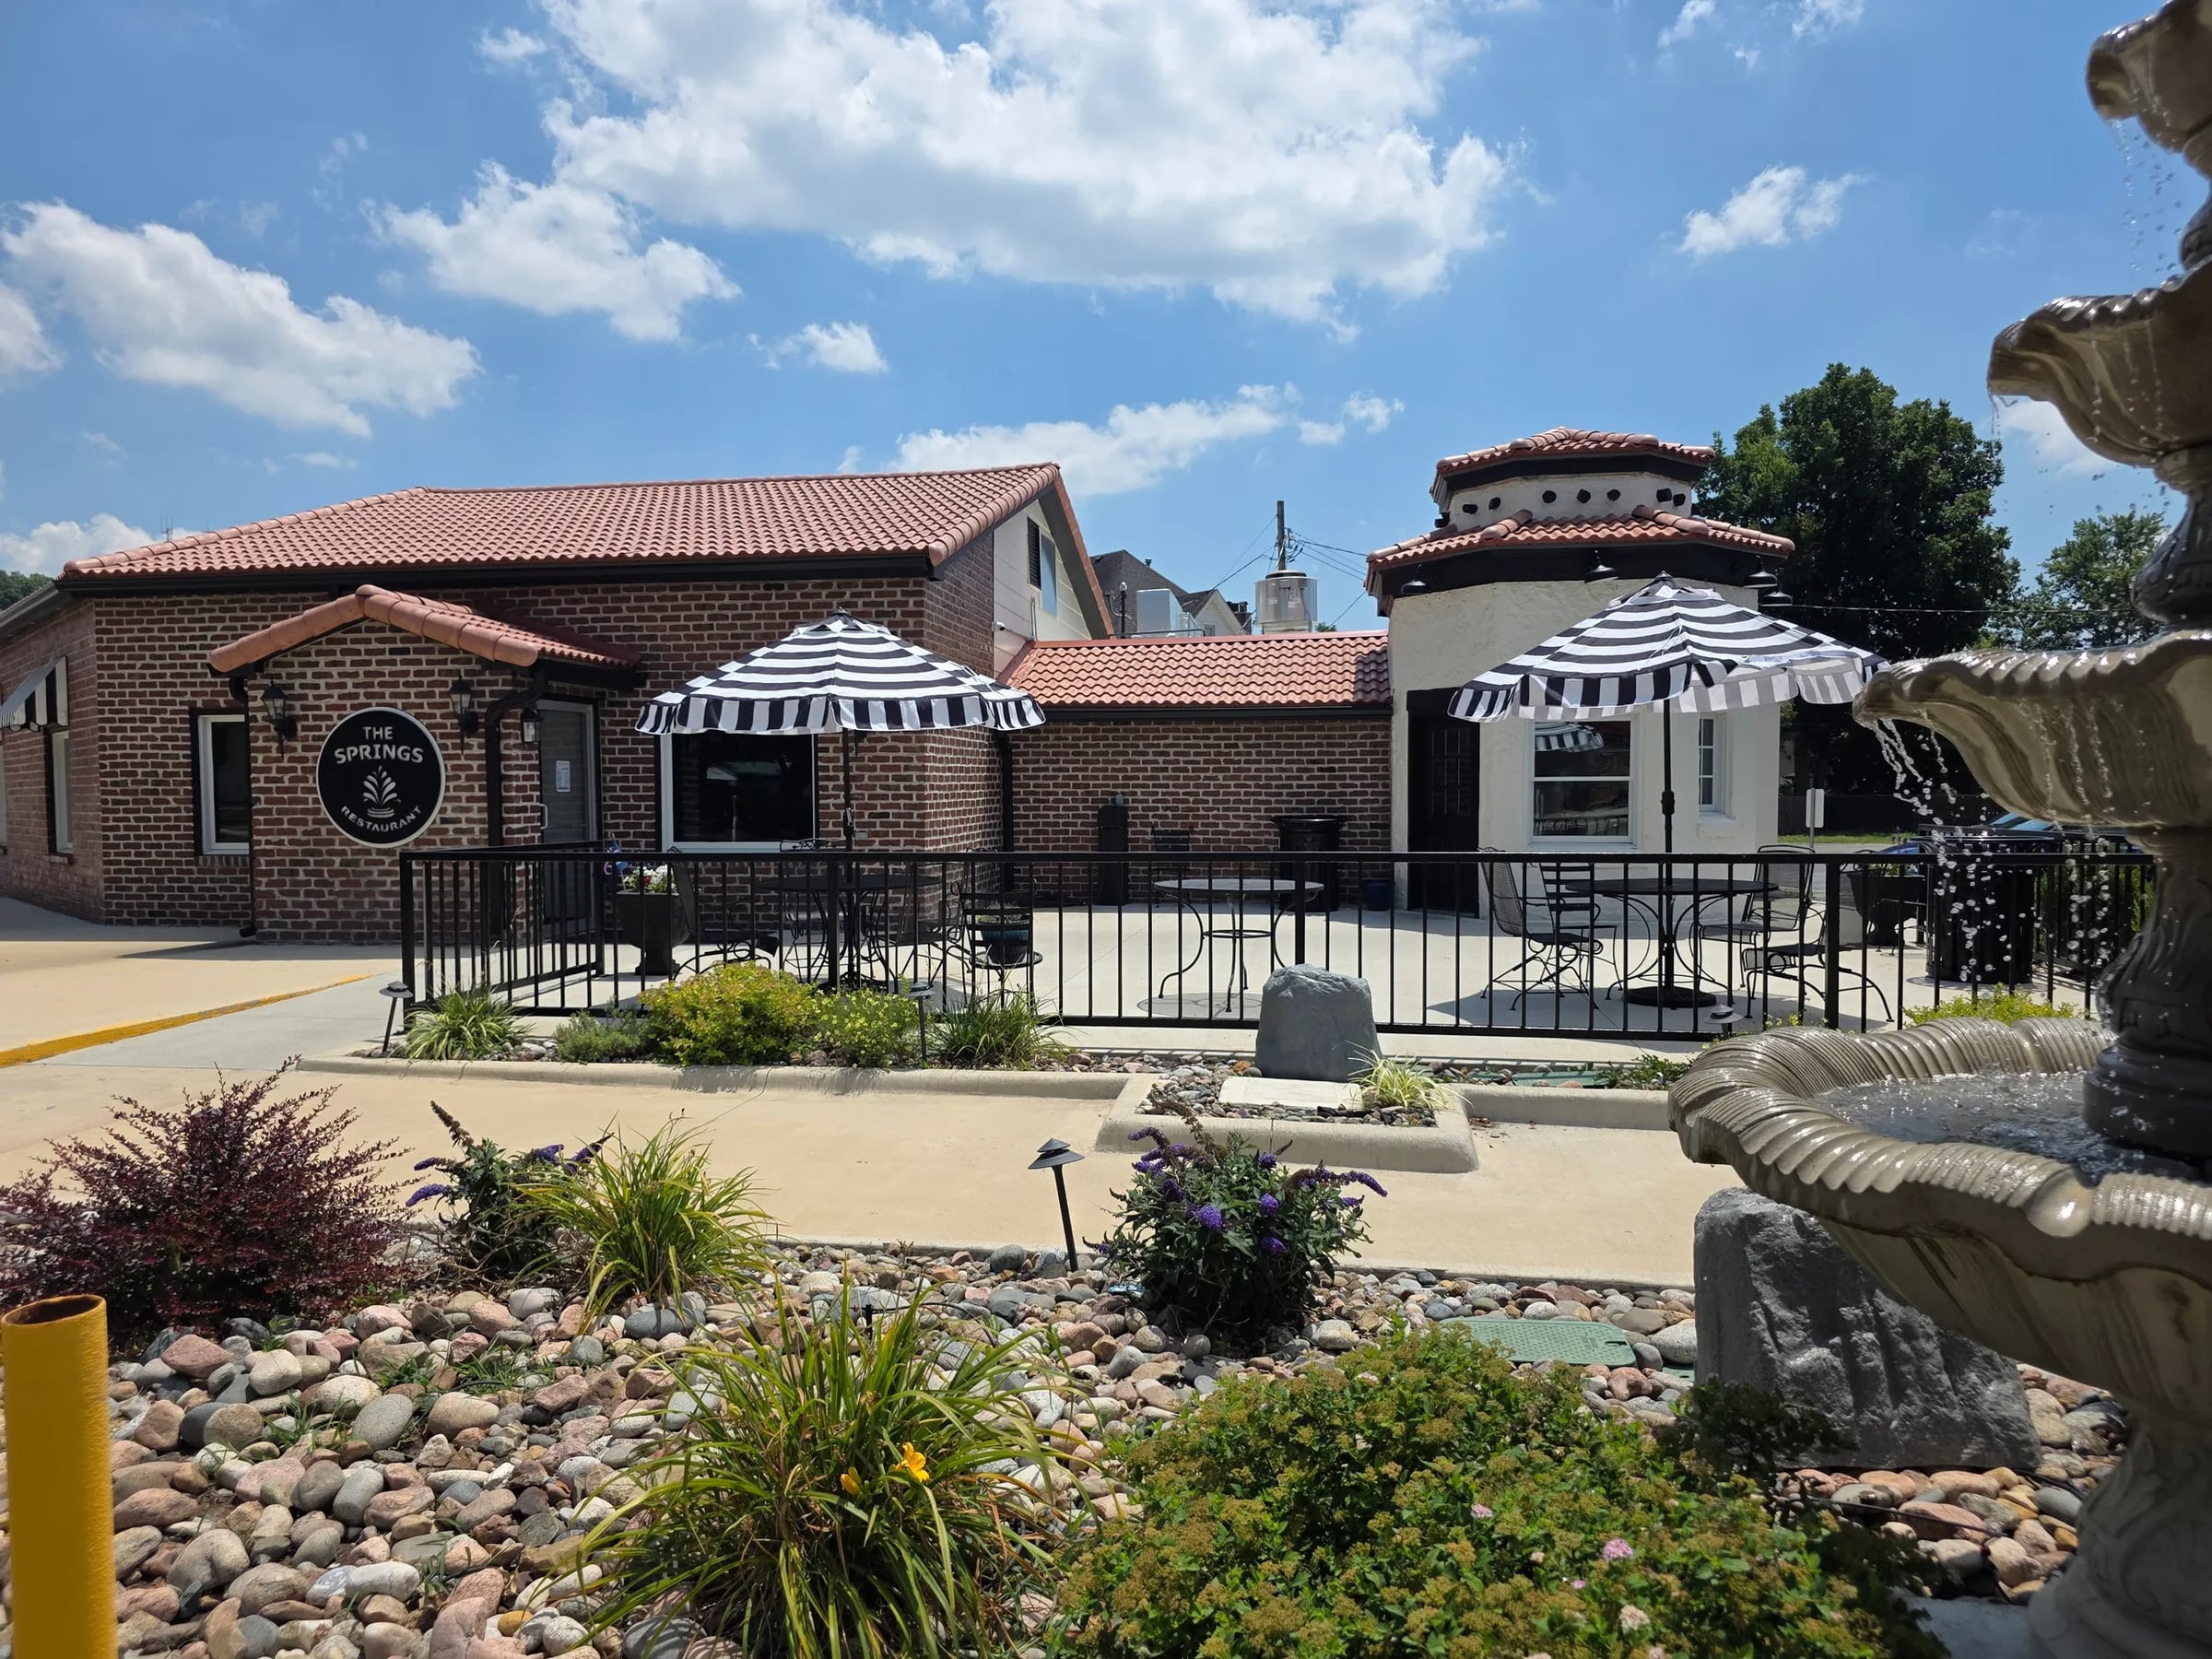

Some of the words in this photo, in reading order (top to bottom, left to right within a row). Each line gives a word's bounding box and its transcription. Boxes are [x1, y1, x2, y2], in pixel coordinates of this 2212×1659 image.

[363, 726, 394, 740] THE
[334, 744, 424, 764] SPRINGS
[341, 806, 422, 832] RESTAURANT
